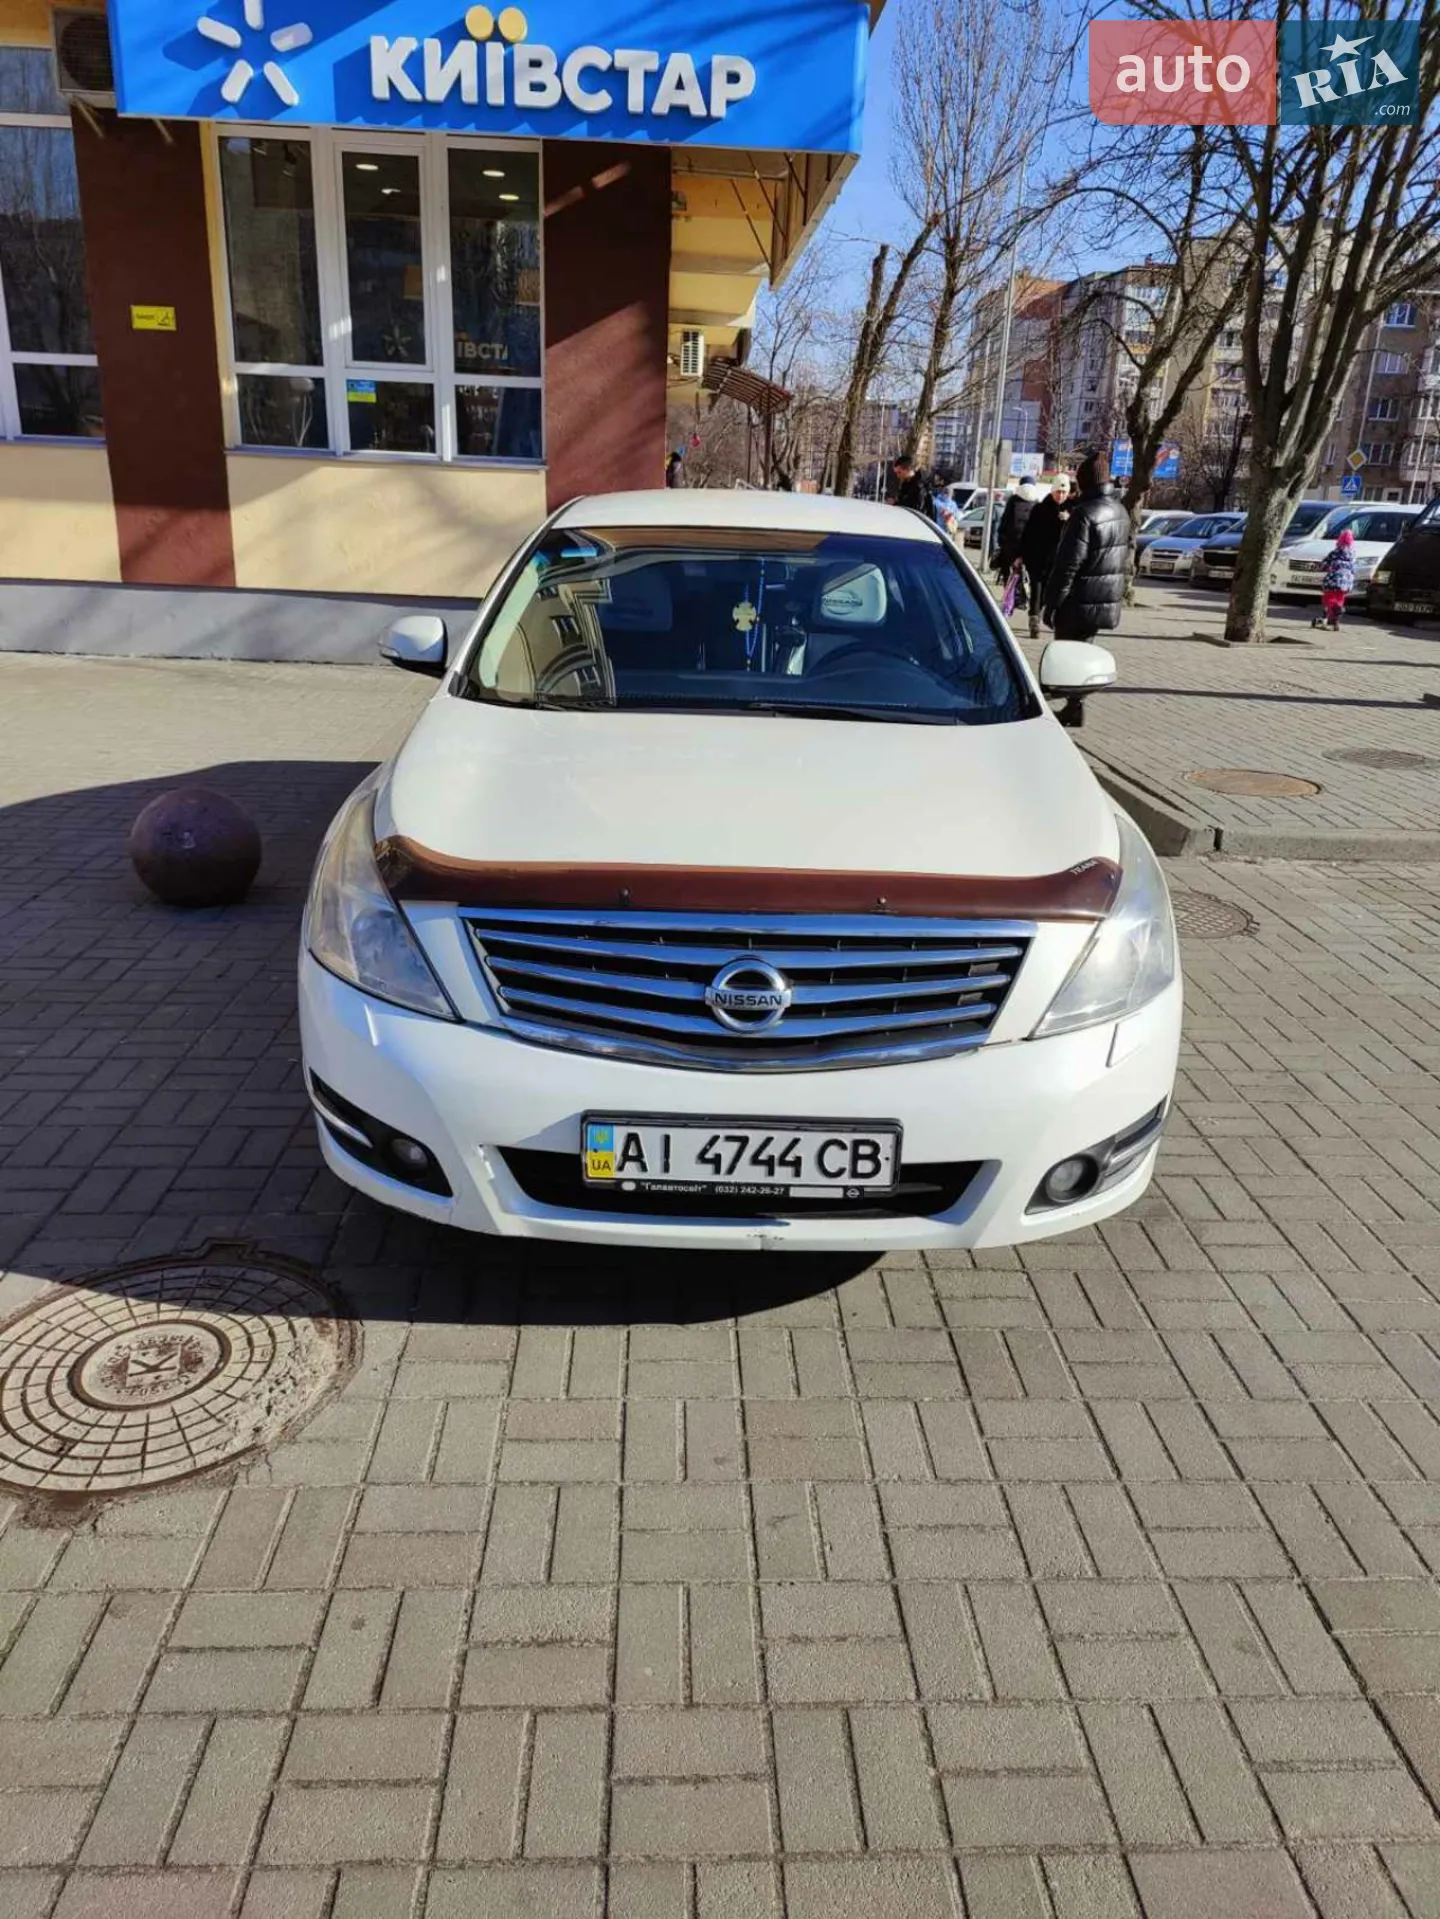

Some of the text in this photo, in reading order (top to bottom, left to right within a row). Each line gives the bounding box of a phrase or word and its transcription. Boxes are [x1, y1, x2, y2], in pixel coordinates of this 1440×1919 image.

[370, 4, 757, 119] КИЇВСТАР
[714, 992, 783, 1006] NISSAN
[592, 1160, 612, 1172] UA
[616, 1132, 882, 1180] AI 4744 CB
